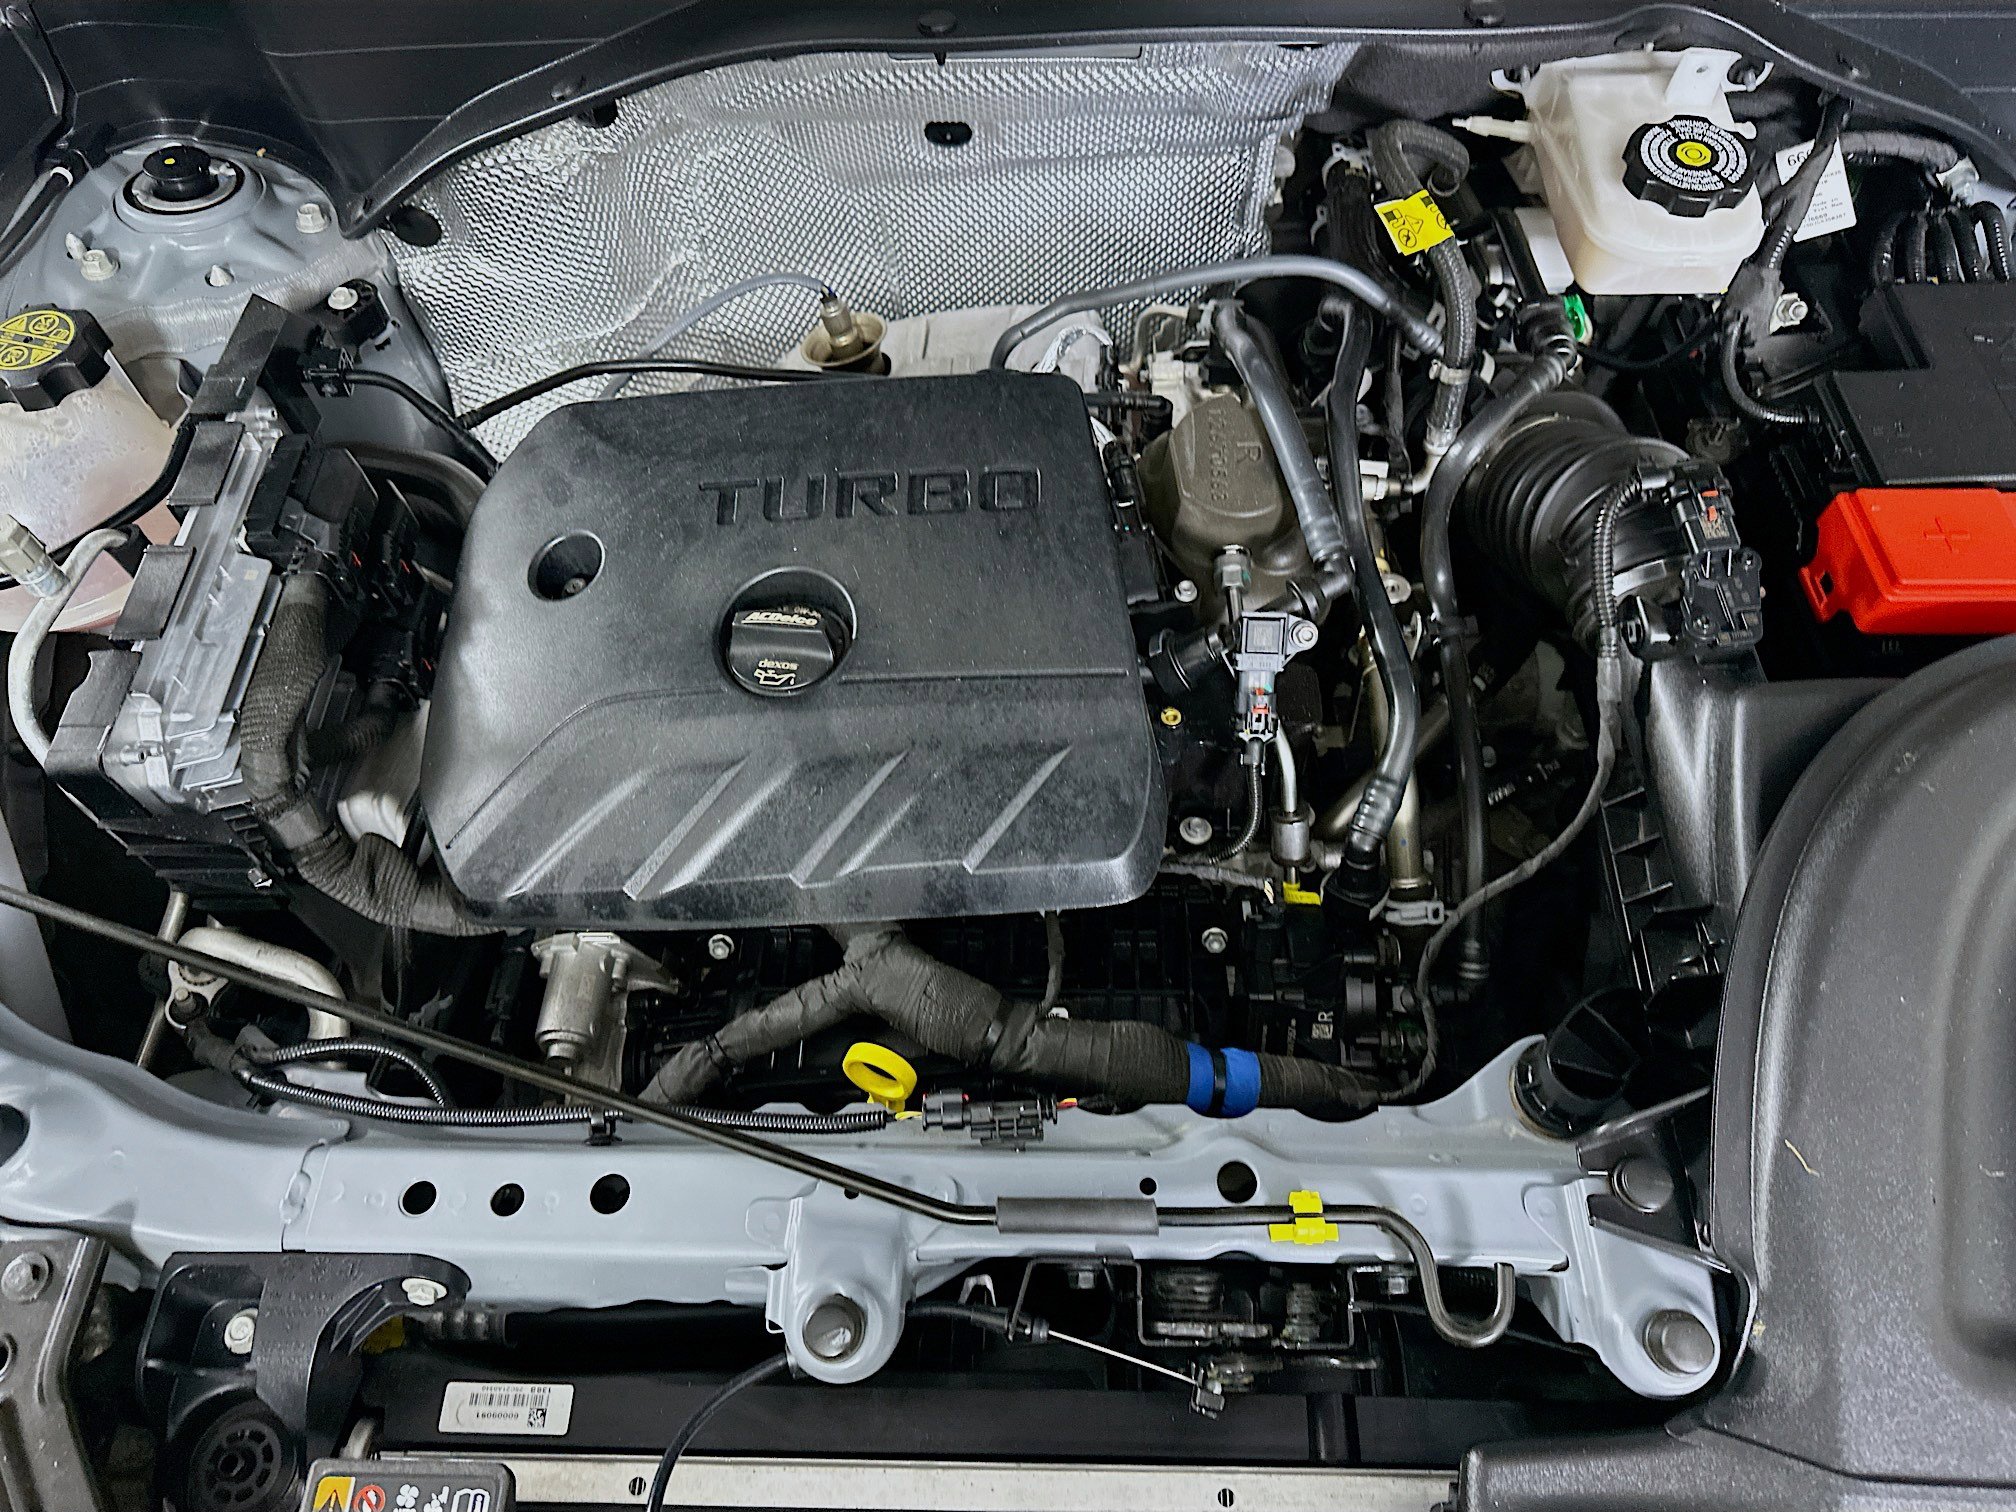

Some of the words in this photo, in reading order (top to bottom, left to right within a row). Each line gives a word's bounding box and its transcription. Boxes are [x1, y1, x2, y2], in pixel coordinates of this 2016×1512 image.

[699, 466, 1042, 526] TURBO
[741, 611, 818, 627] ACDelco
[758, 658, 799, 671] dexos
